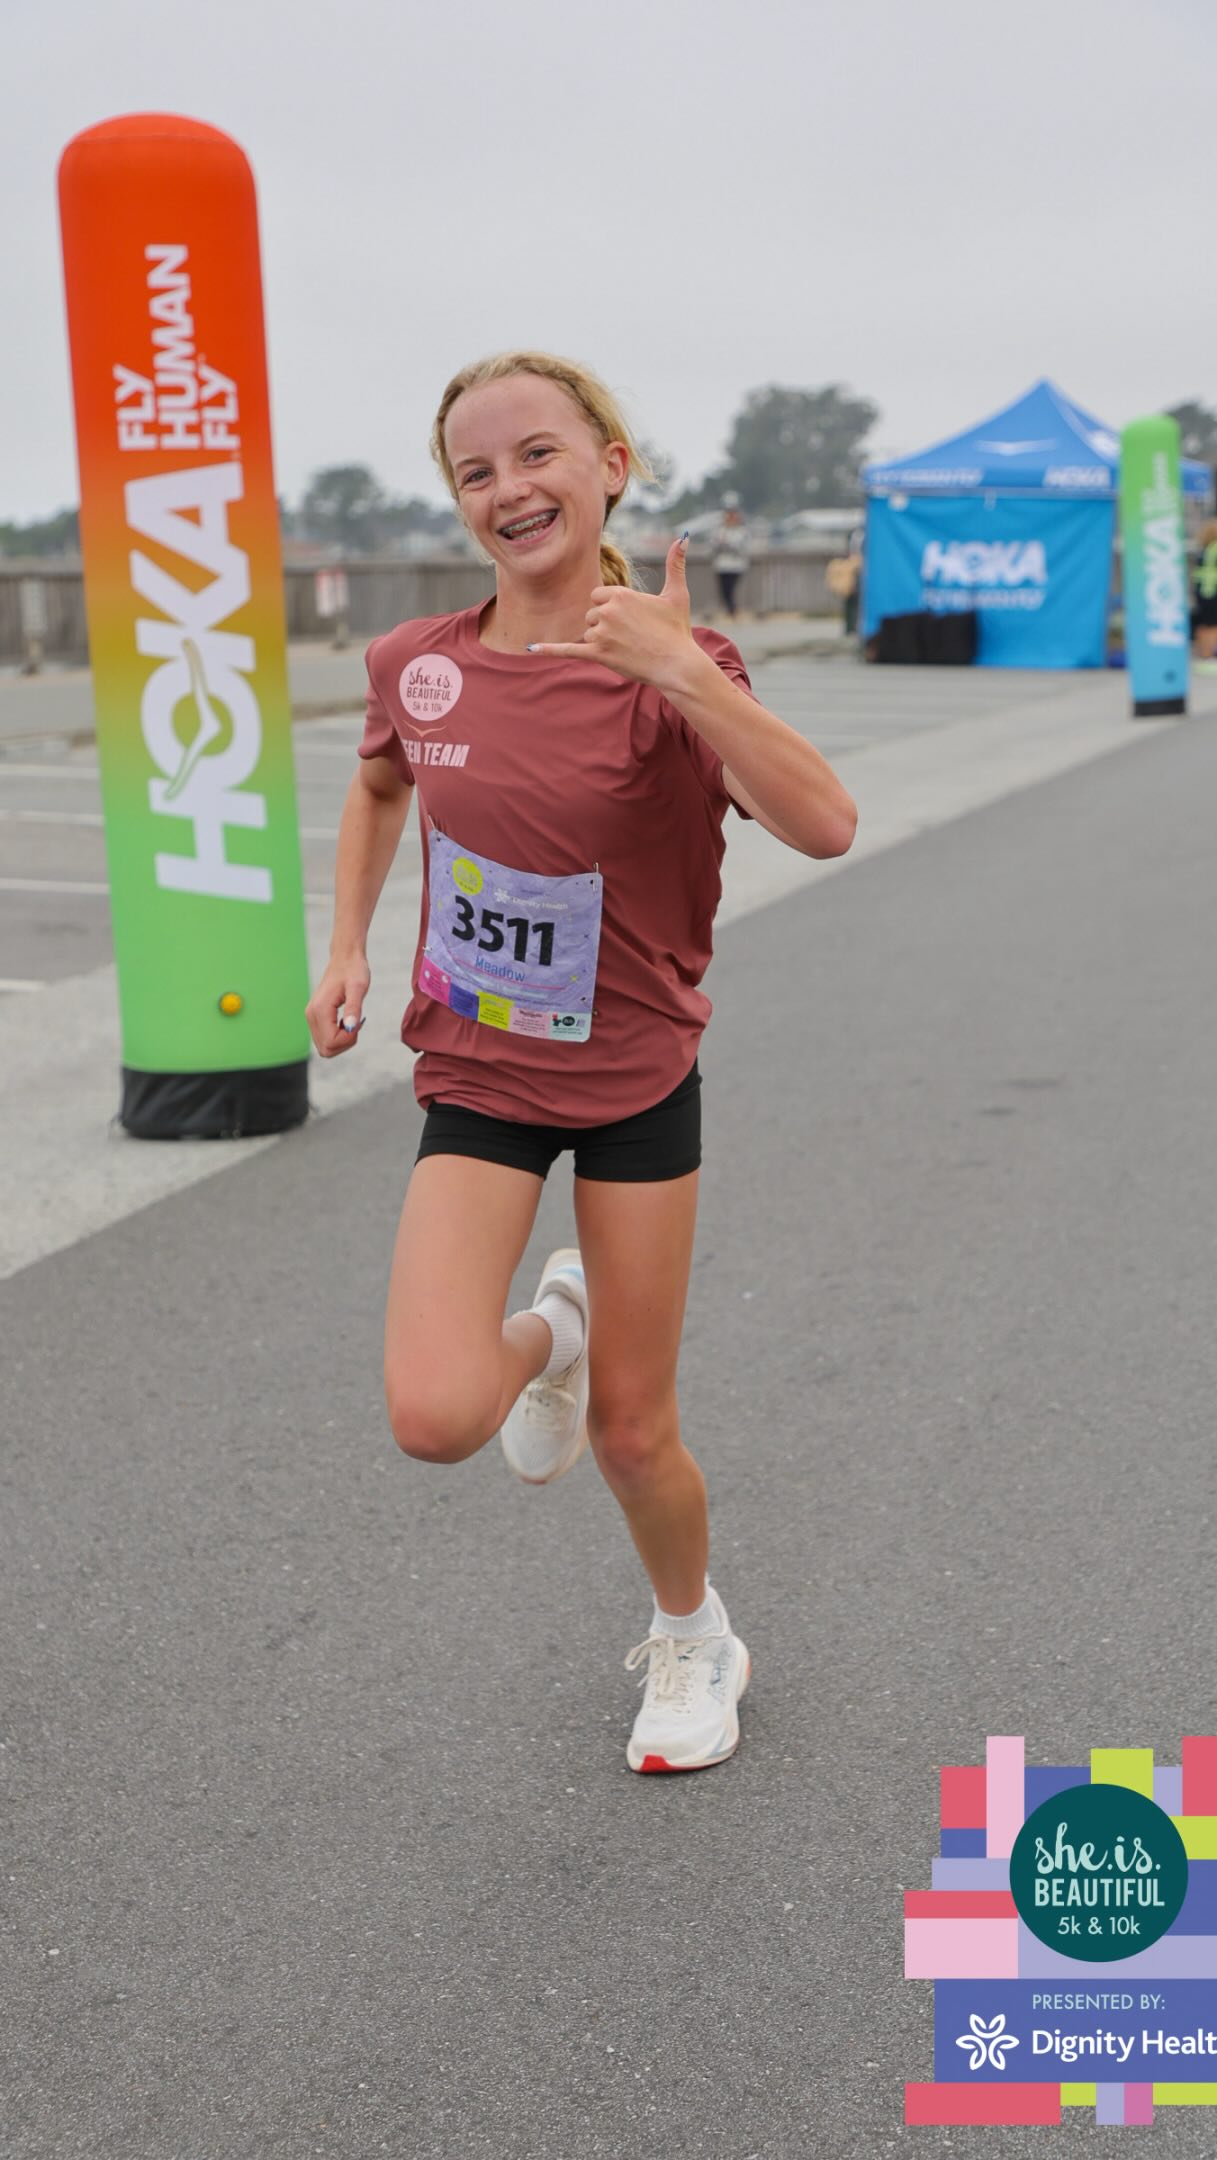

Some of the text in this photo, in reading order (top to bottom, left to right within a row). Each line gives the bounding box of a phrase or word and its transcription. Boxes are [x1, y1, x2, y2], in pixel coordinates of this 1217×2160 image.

[144, 244, 201, 450] HUMAN
[112, 363, 159, 451] FLY
[198, 361, 241, 450] FLY
[920, 540, 1048, 586] HOKA
[1143, 515, 1187, 646] HOKA
[124, 461, 273, 904] HOKA
[406, 686, 452, 702] BEAUTIFUL
[423, 702, 429, 712] &
[401, 739, 471, 768] EEN TEAM
[452, 894, 555, 967] 3511
[475, 954, 526, 983] Meadow
